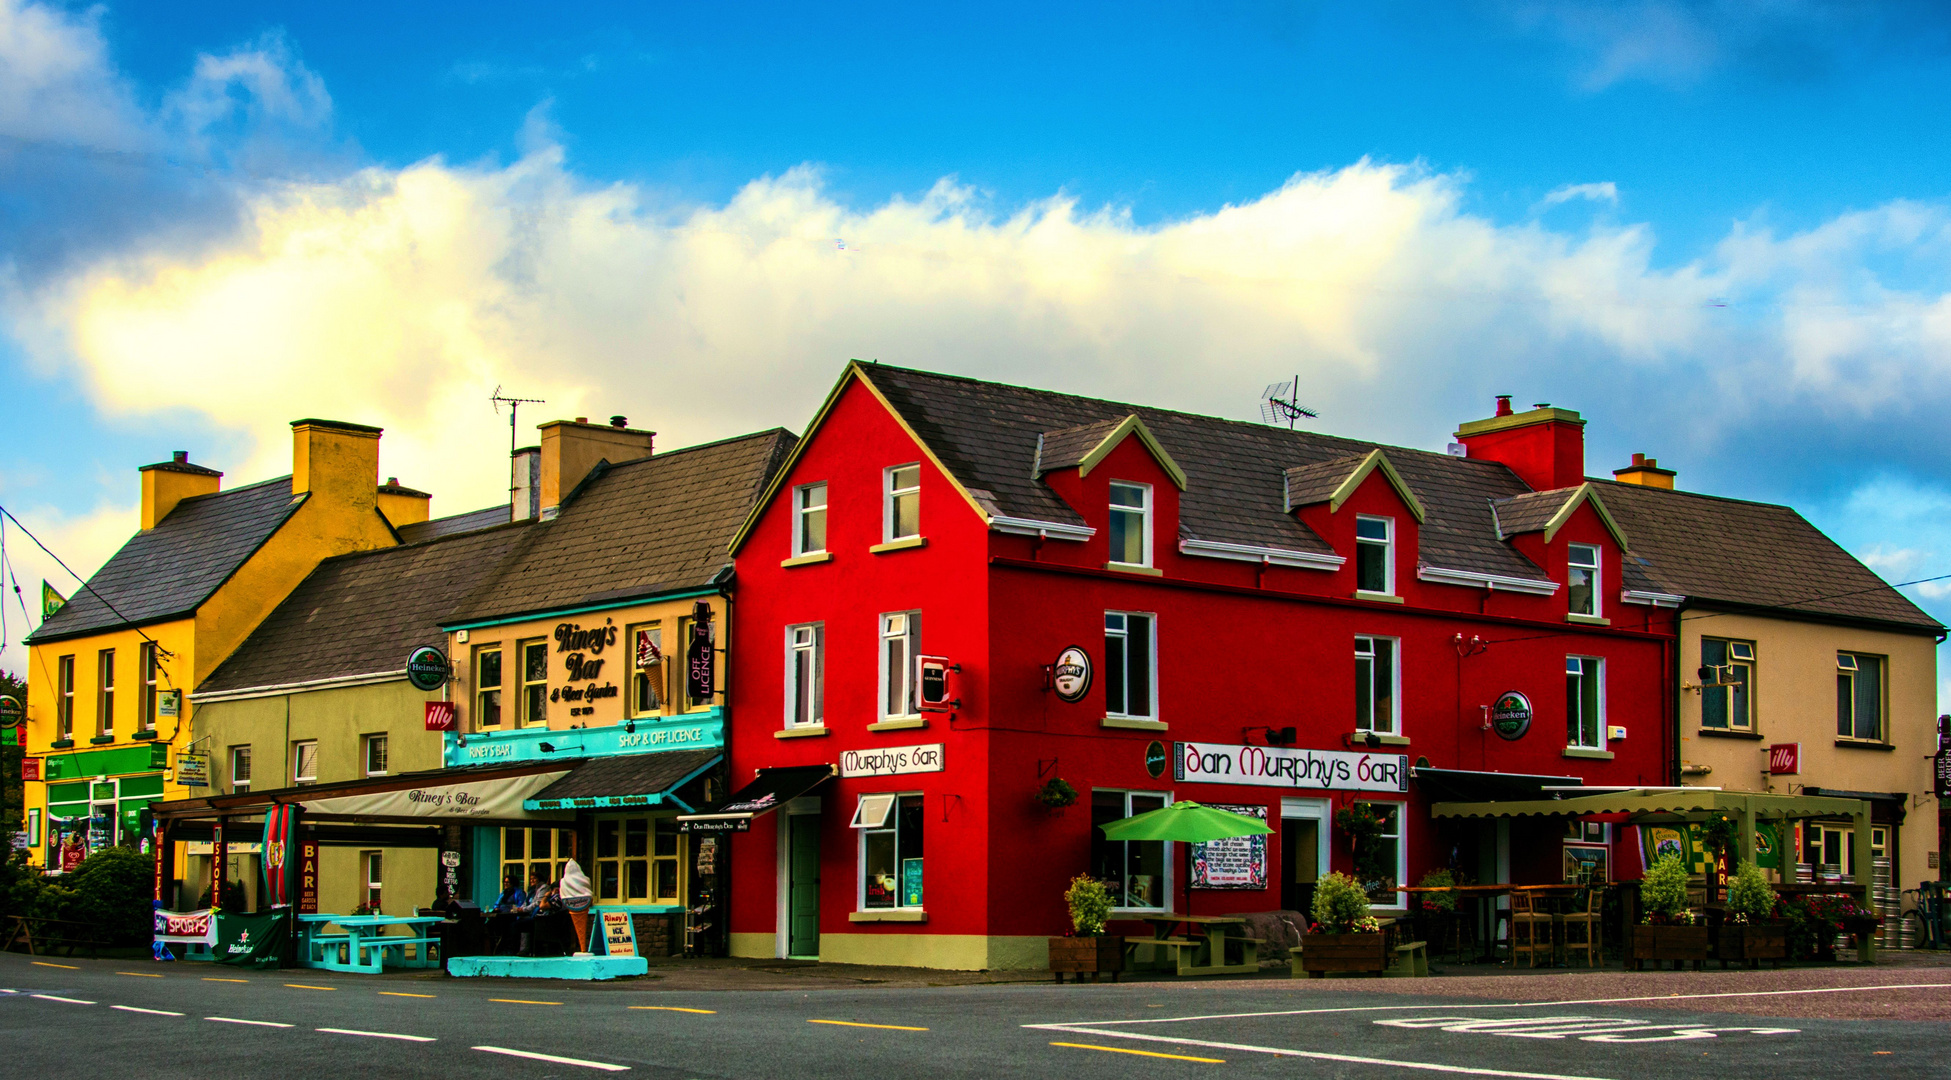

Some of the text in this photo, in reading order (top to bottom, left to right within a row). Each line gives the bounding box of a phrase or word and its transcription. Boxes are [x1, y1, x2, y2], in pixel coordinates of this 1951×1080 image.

[554, 617, 618, 655] Riney's
[412, 663, 446, 673] Heineken
[565, 652, 605, 682] Bar
[692, 657, 700, 680] OFF
[701, 646, 711, 694] LICENCE
[561, 685, 584, 702] Beer
[584, 681, 618, 704] Garden
[427, 705, 453, 729] illy
[619, 727, 702, 747] SHOP & OFF LICENCE
[469, 743, 511, 758] RINEY'S BAR
[845, 749, 907, 774] Murphy's
[1772, 749, 1794, 770] illy
[1186, 743, 1399, 788] Dan Murphy's Bar
[409, 789, 480, 806] Riney's Bar
[155, 848, 164, 901] BEER
[213, 844, 221, 904] SPORT
[304, 845, 315, 888] BAR
[868, 884, 885, 896] Irish
[169, 917, 208, 934] SPORTS
[604, 913, 628, 923] Riney's
[608, 935, 633, 945] CREAM
[612, 926, 624, 935] ICE
